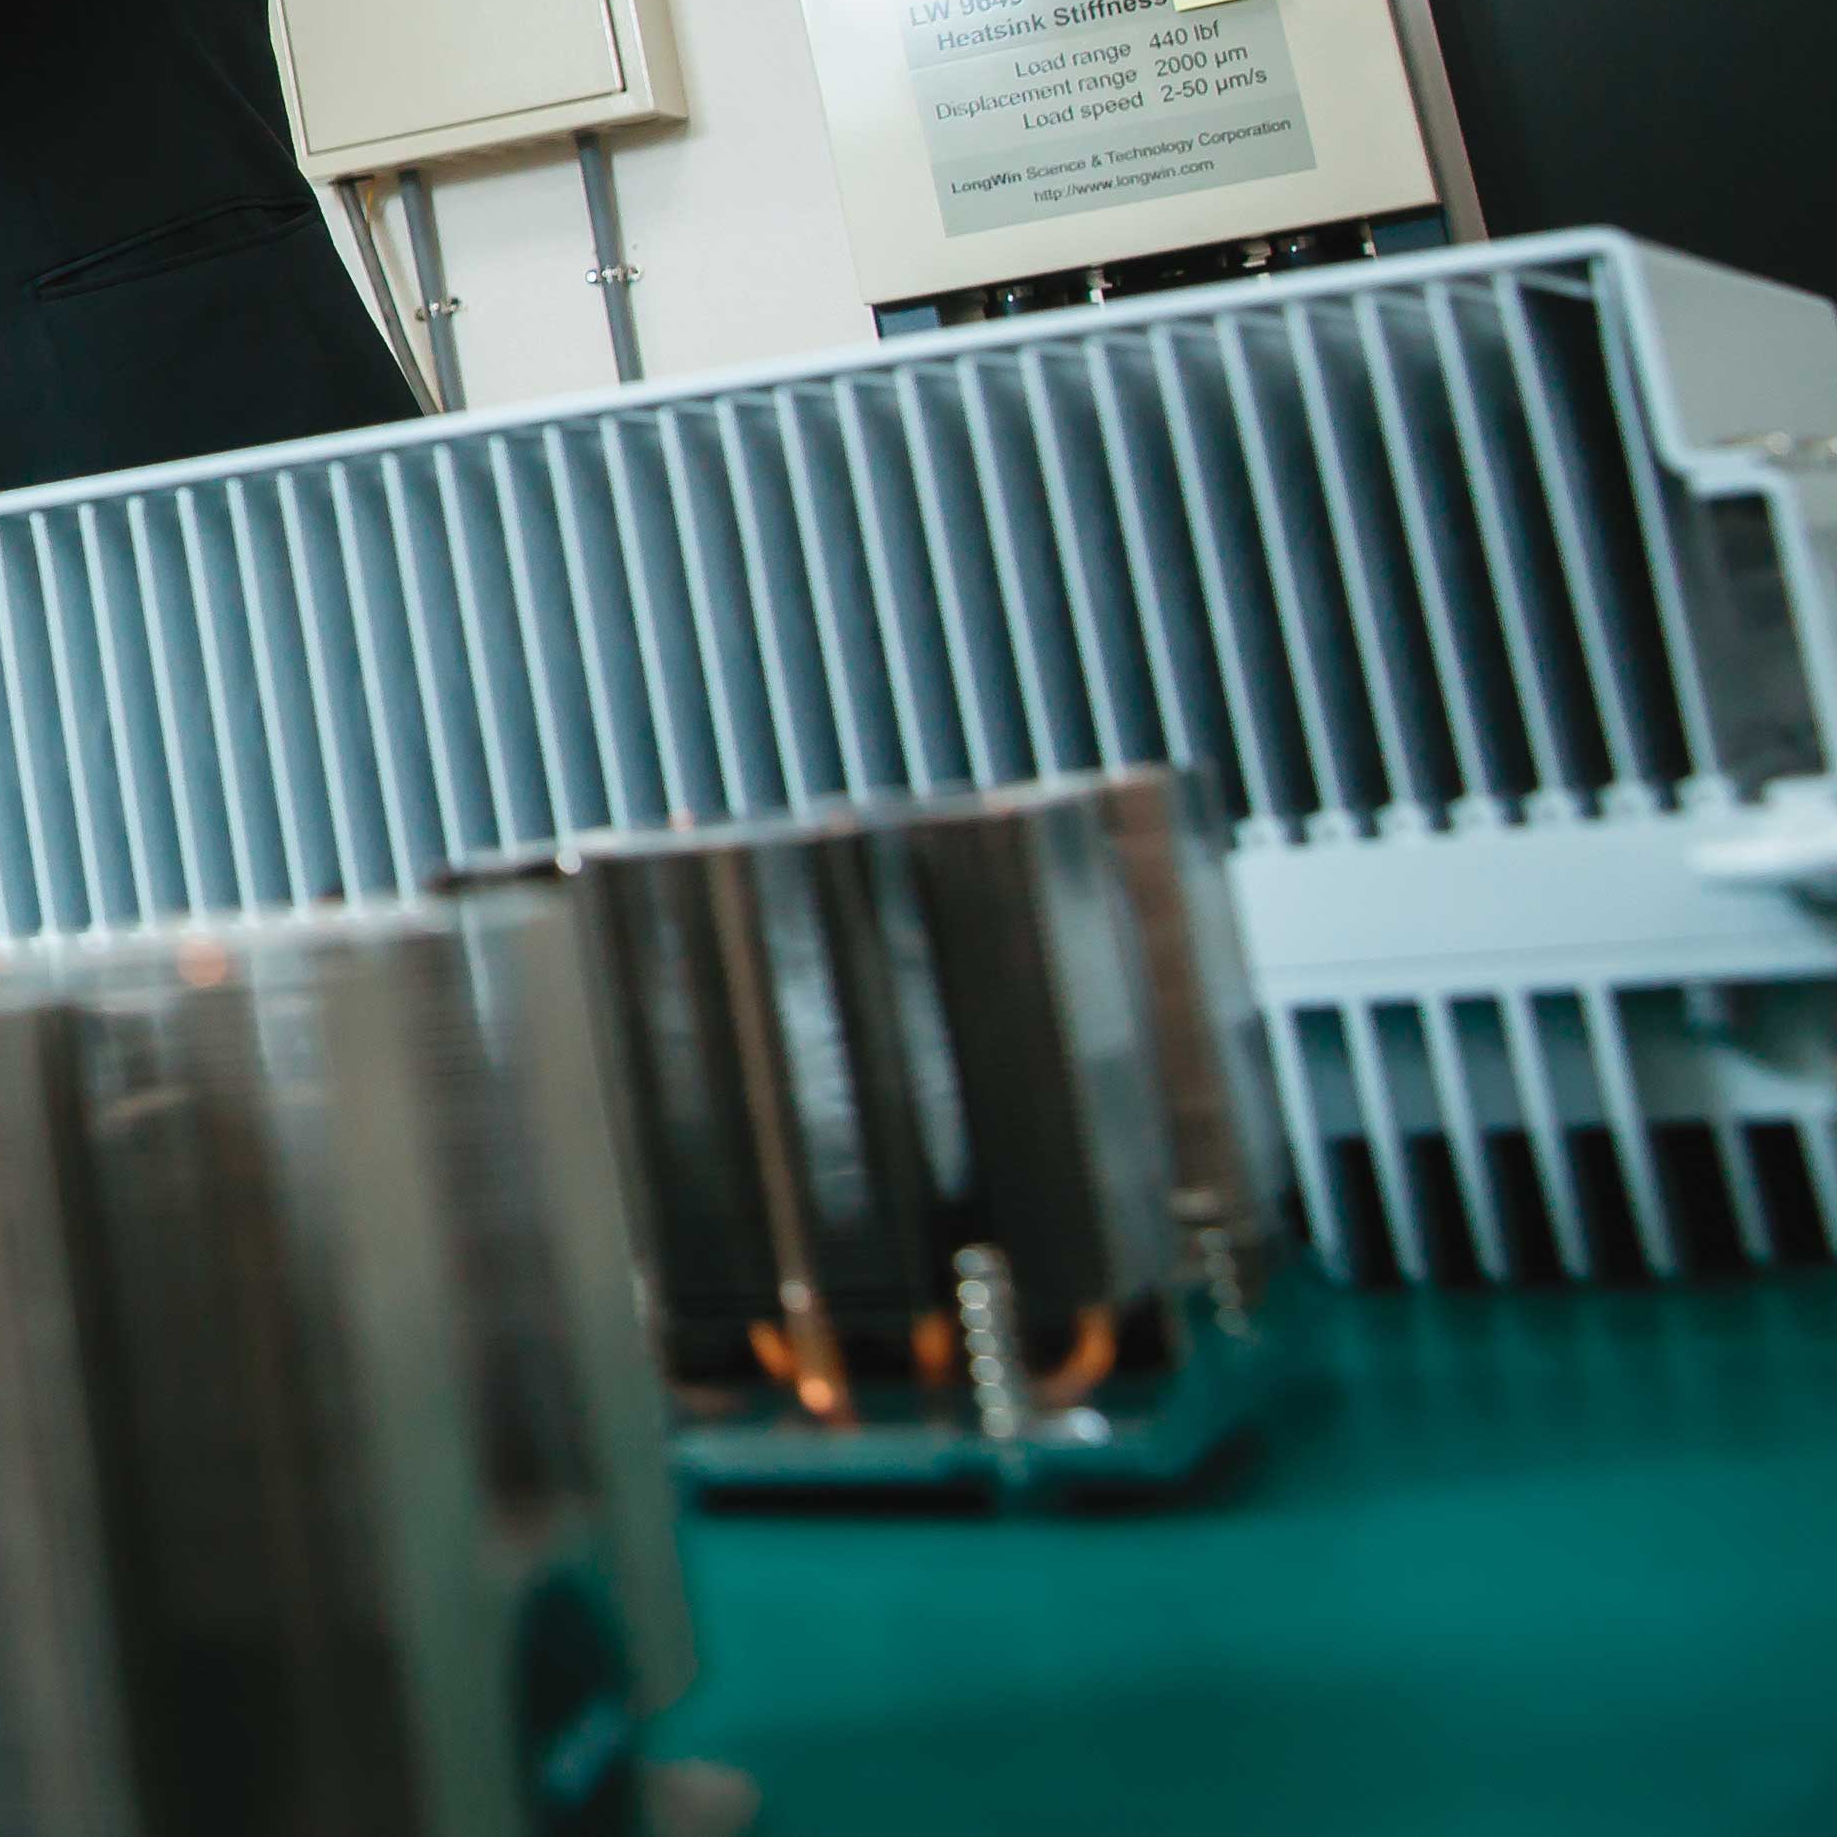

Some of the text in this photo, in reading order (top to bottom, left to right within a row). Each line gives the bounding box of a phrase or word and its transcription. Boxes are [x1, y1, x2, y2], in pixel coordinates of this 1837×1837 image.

[909, 0, 950, 27] LW
[937, 13, 1048, 51] Heatsink
[1015, 19, 1220, 78] Load range 440 lbf
[935, 79, 1073, 120] Displacement
[1077, 68, 1137, 93] range
[1154, 51, 1208, 78] 2000
[1022, 105, 1074, 130] Load
[1080, 90, 1144, 121] speed
[1160, 78, 1209, 103] 2-50
[951, 119, 1292, 195] LongWin Science & Technology Corporation
[1033, 159, 1215, 203] http://www.longwin.com
